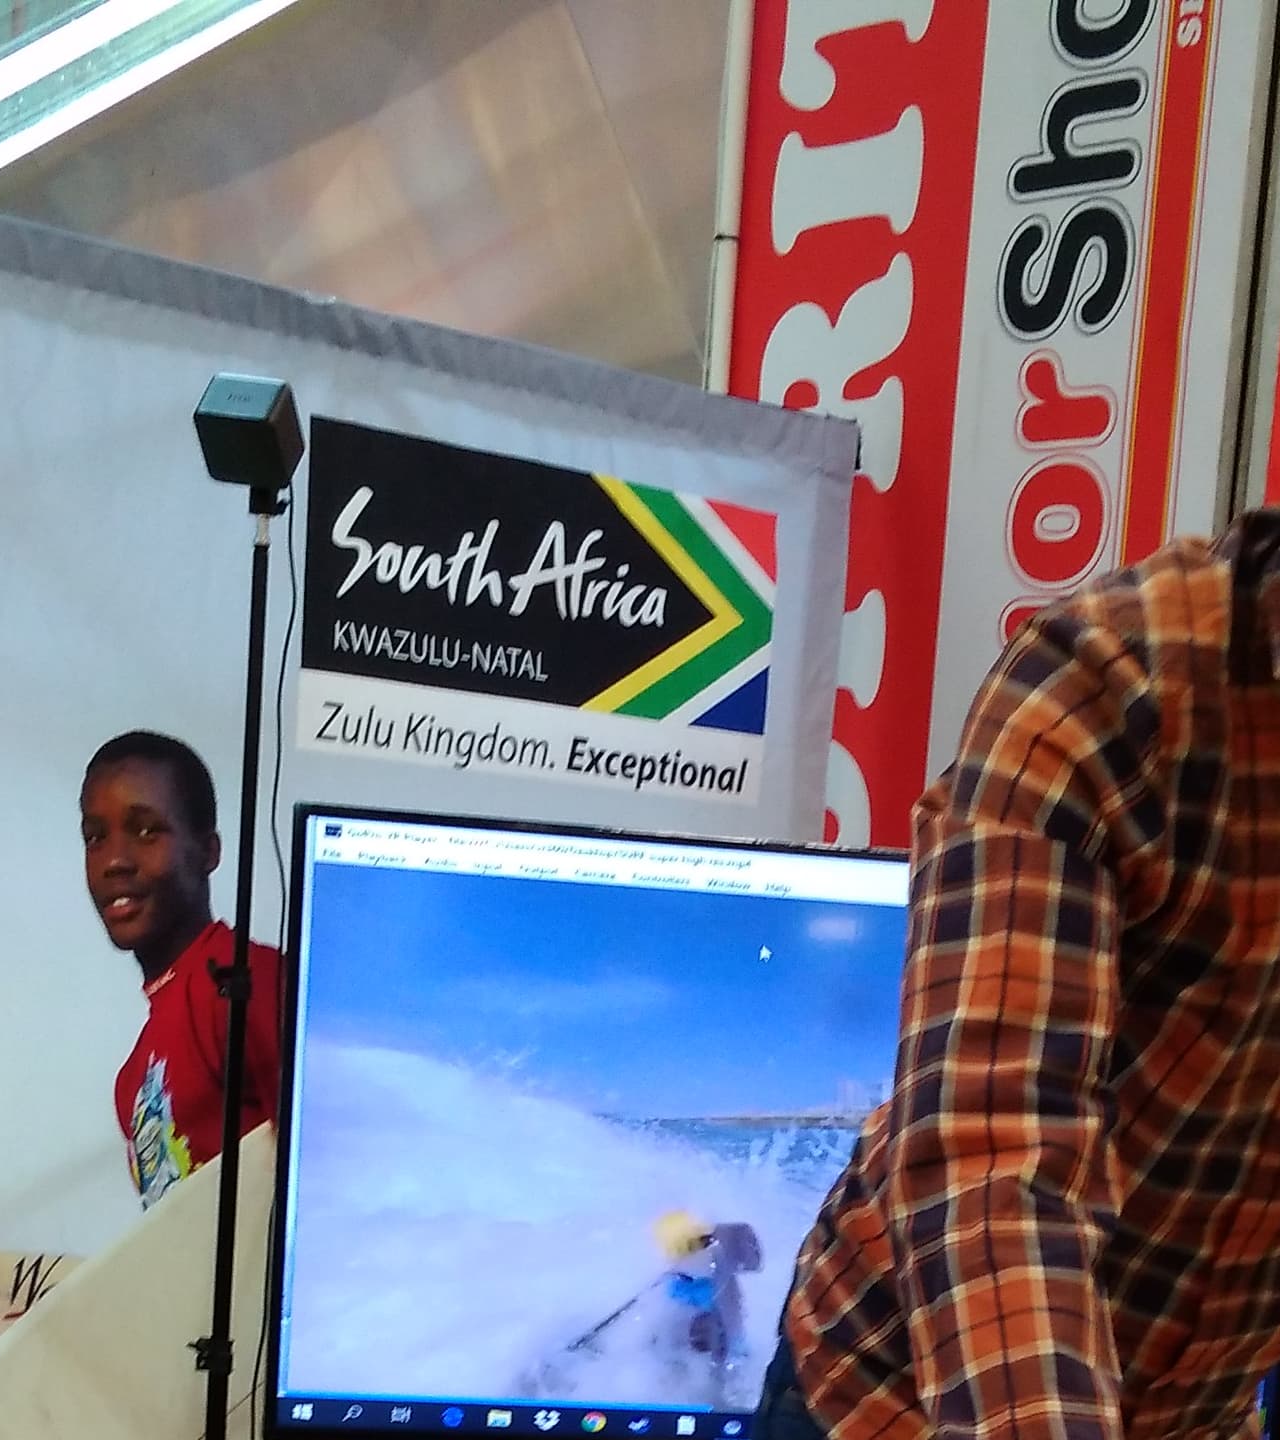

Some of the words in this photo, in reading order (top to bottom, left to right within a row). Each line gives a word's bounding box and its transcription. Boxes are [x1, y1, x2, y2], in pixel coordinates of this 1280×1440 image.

[330, 485, 502, 608] South
[508, 519, 667, 629] Africa
[333, 619, 549, 683] KWAZULU-NATAL
[316, 701, 395, 750] Zulu
[403, 713, 556, 772] Kingdom.
[567, 736, 750, 796] Exceptional
